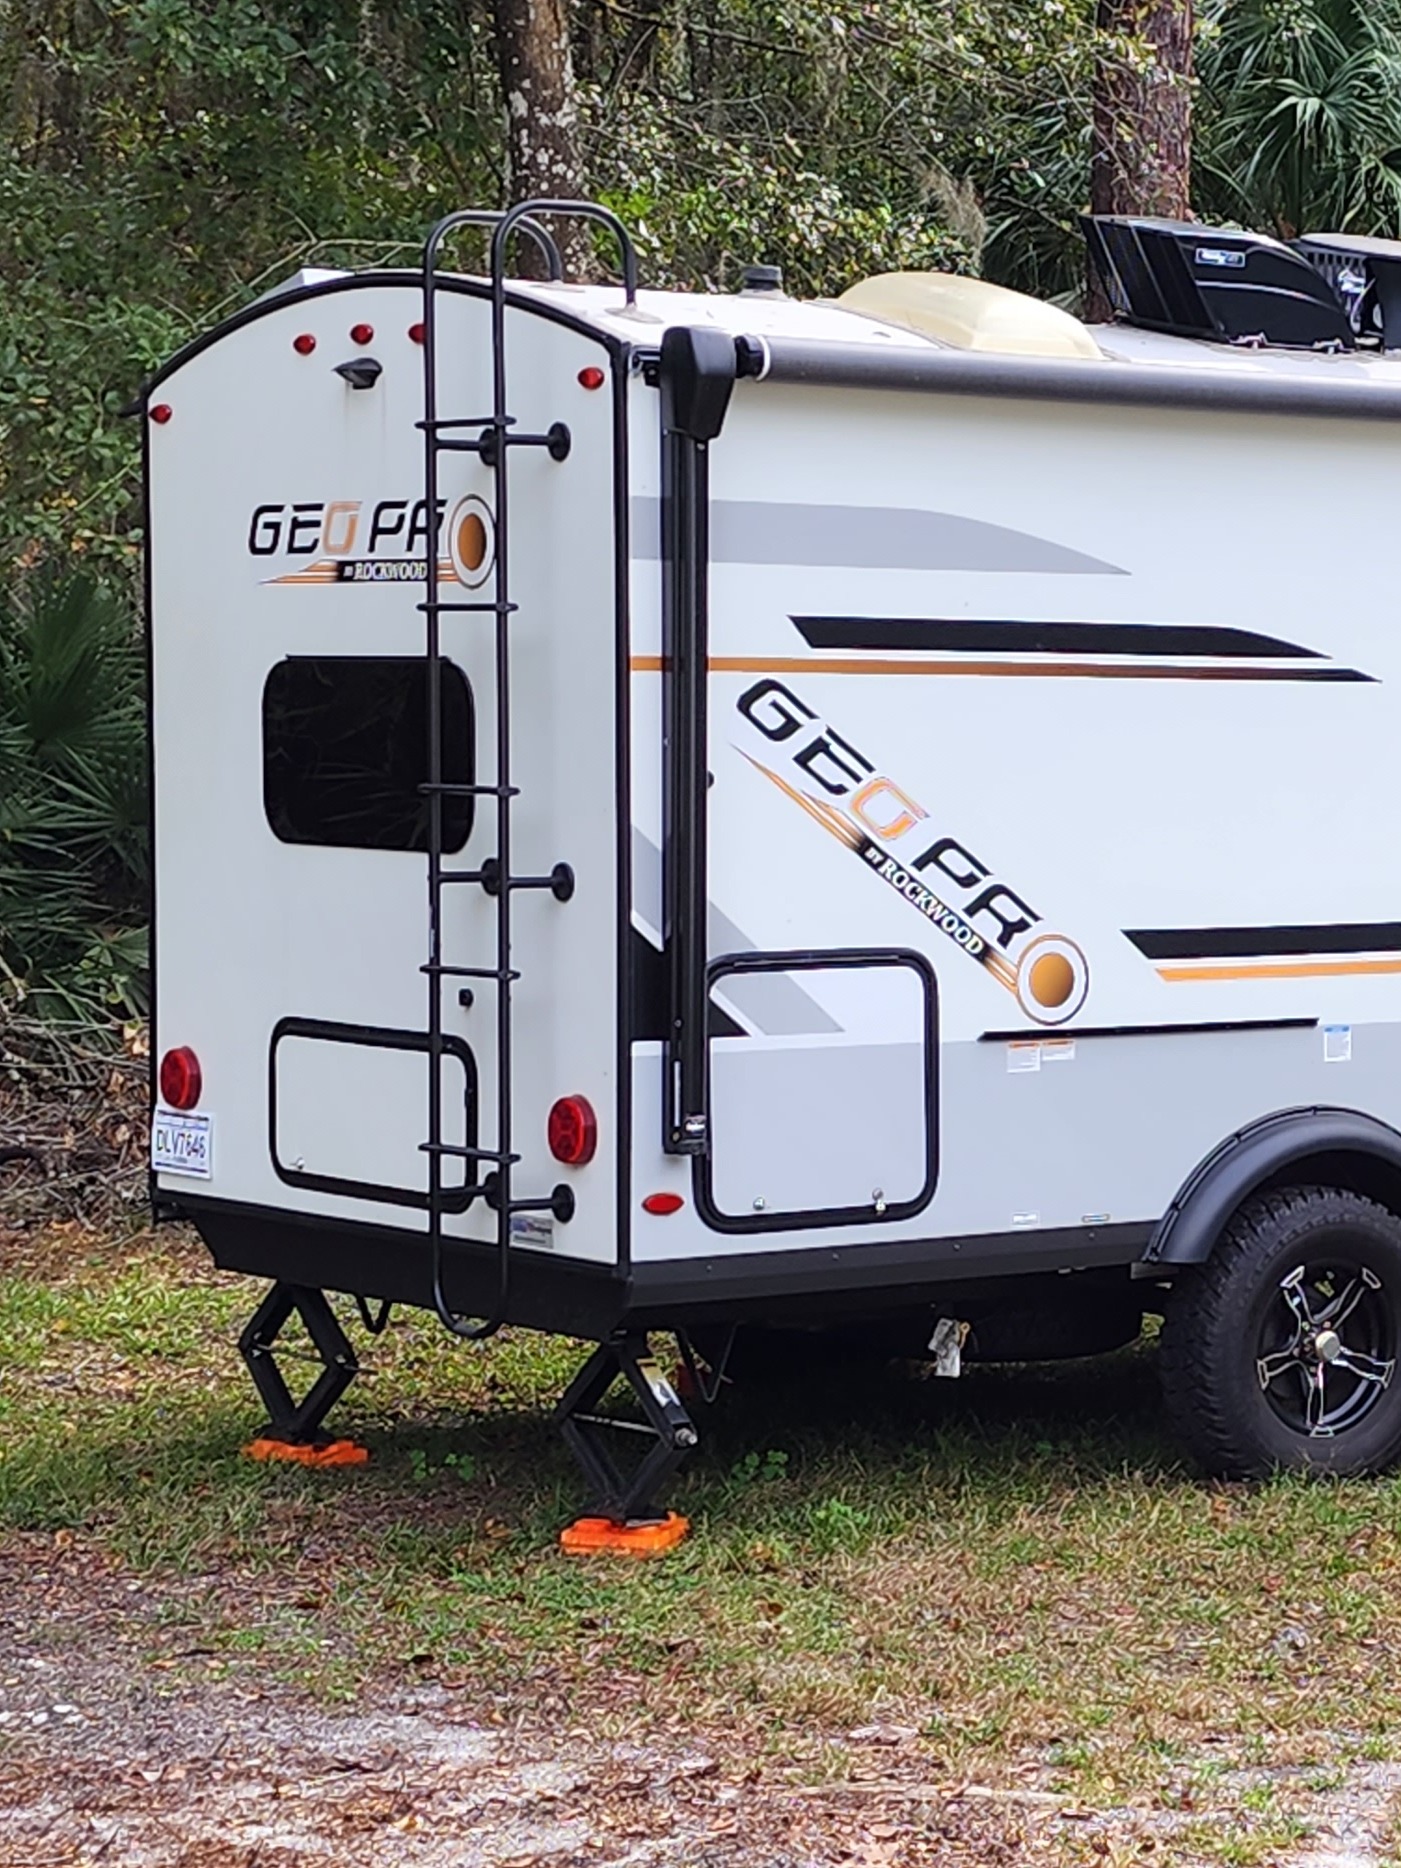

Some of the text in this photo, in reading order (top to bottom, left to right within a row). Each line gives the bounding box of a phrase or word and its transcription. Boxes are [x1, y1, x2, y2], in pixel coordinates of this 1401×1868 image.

[248, 501, 362, 555] GEO
[736, 678, 930, 841] GEO
[865, 847, 985, 955] BY ROCKWOOD
